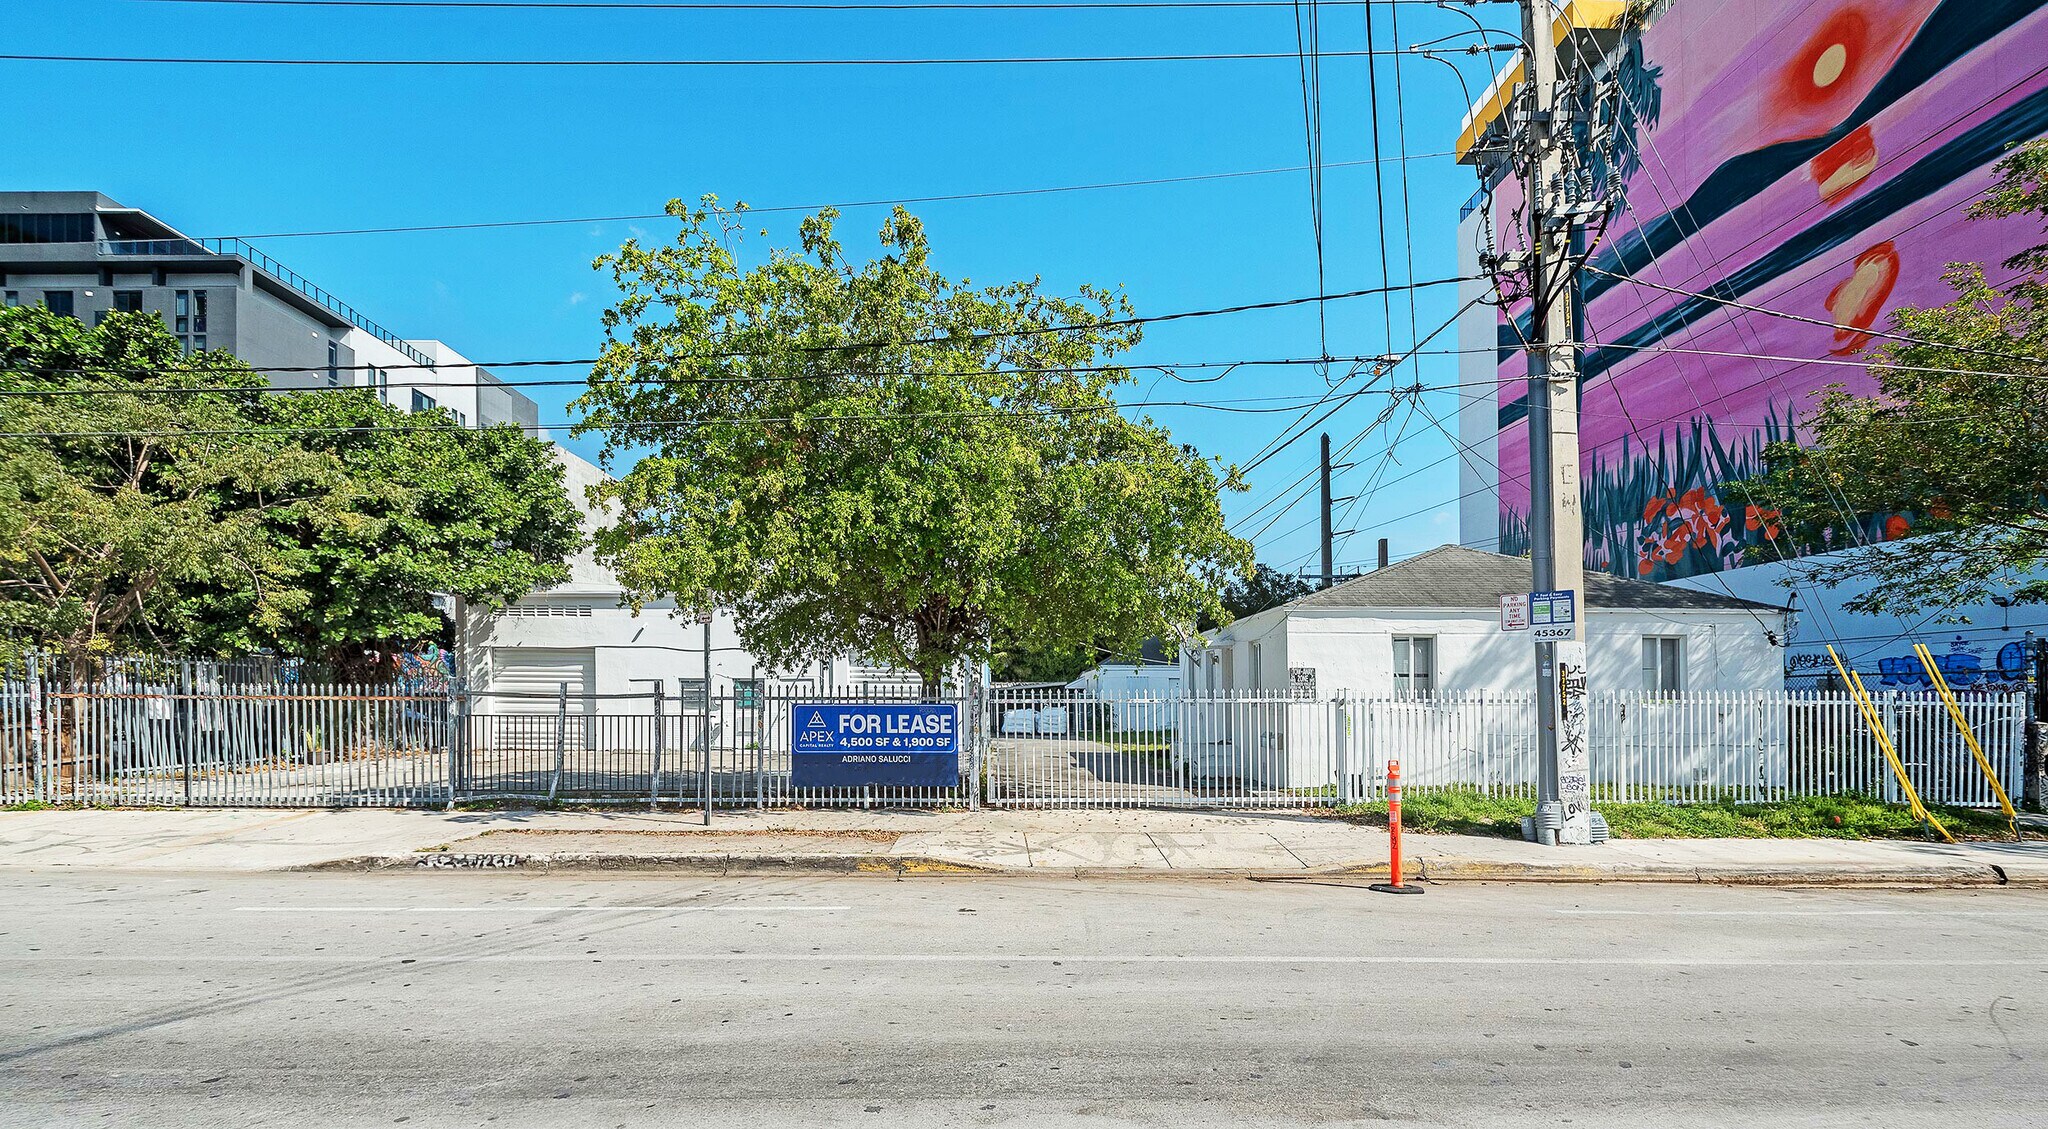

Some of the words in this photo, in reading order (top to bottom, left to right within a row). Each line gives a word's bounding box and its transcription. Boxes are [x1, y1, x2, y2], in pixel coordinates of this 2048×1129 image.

[1534, 628, 1571, 637] 45367
[839, 714, 881, 734] FOR
[886, 714, 952, 734] LEASE
[800, 731, 834, 742] APEX
[840, 737, 873, 748] 4,500
[875, 737, 890, 747] SF
[892, 737, 901, 747] &
[903, 737, 934, 748] 1,900
[936, 737, 951, 747] SF
[841, 755, 877, 763] ADRIANO
[878, 755, 911, 763] SALUCCI
